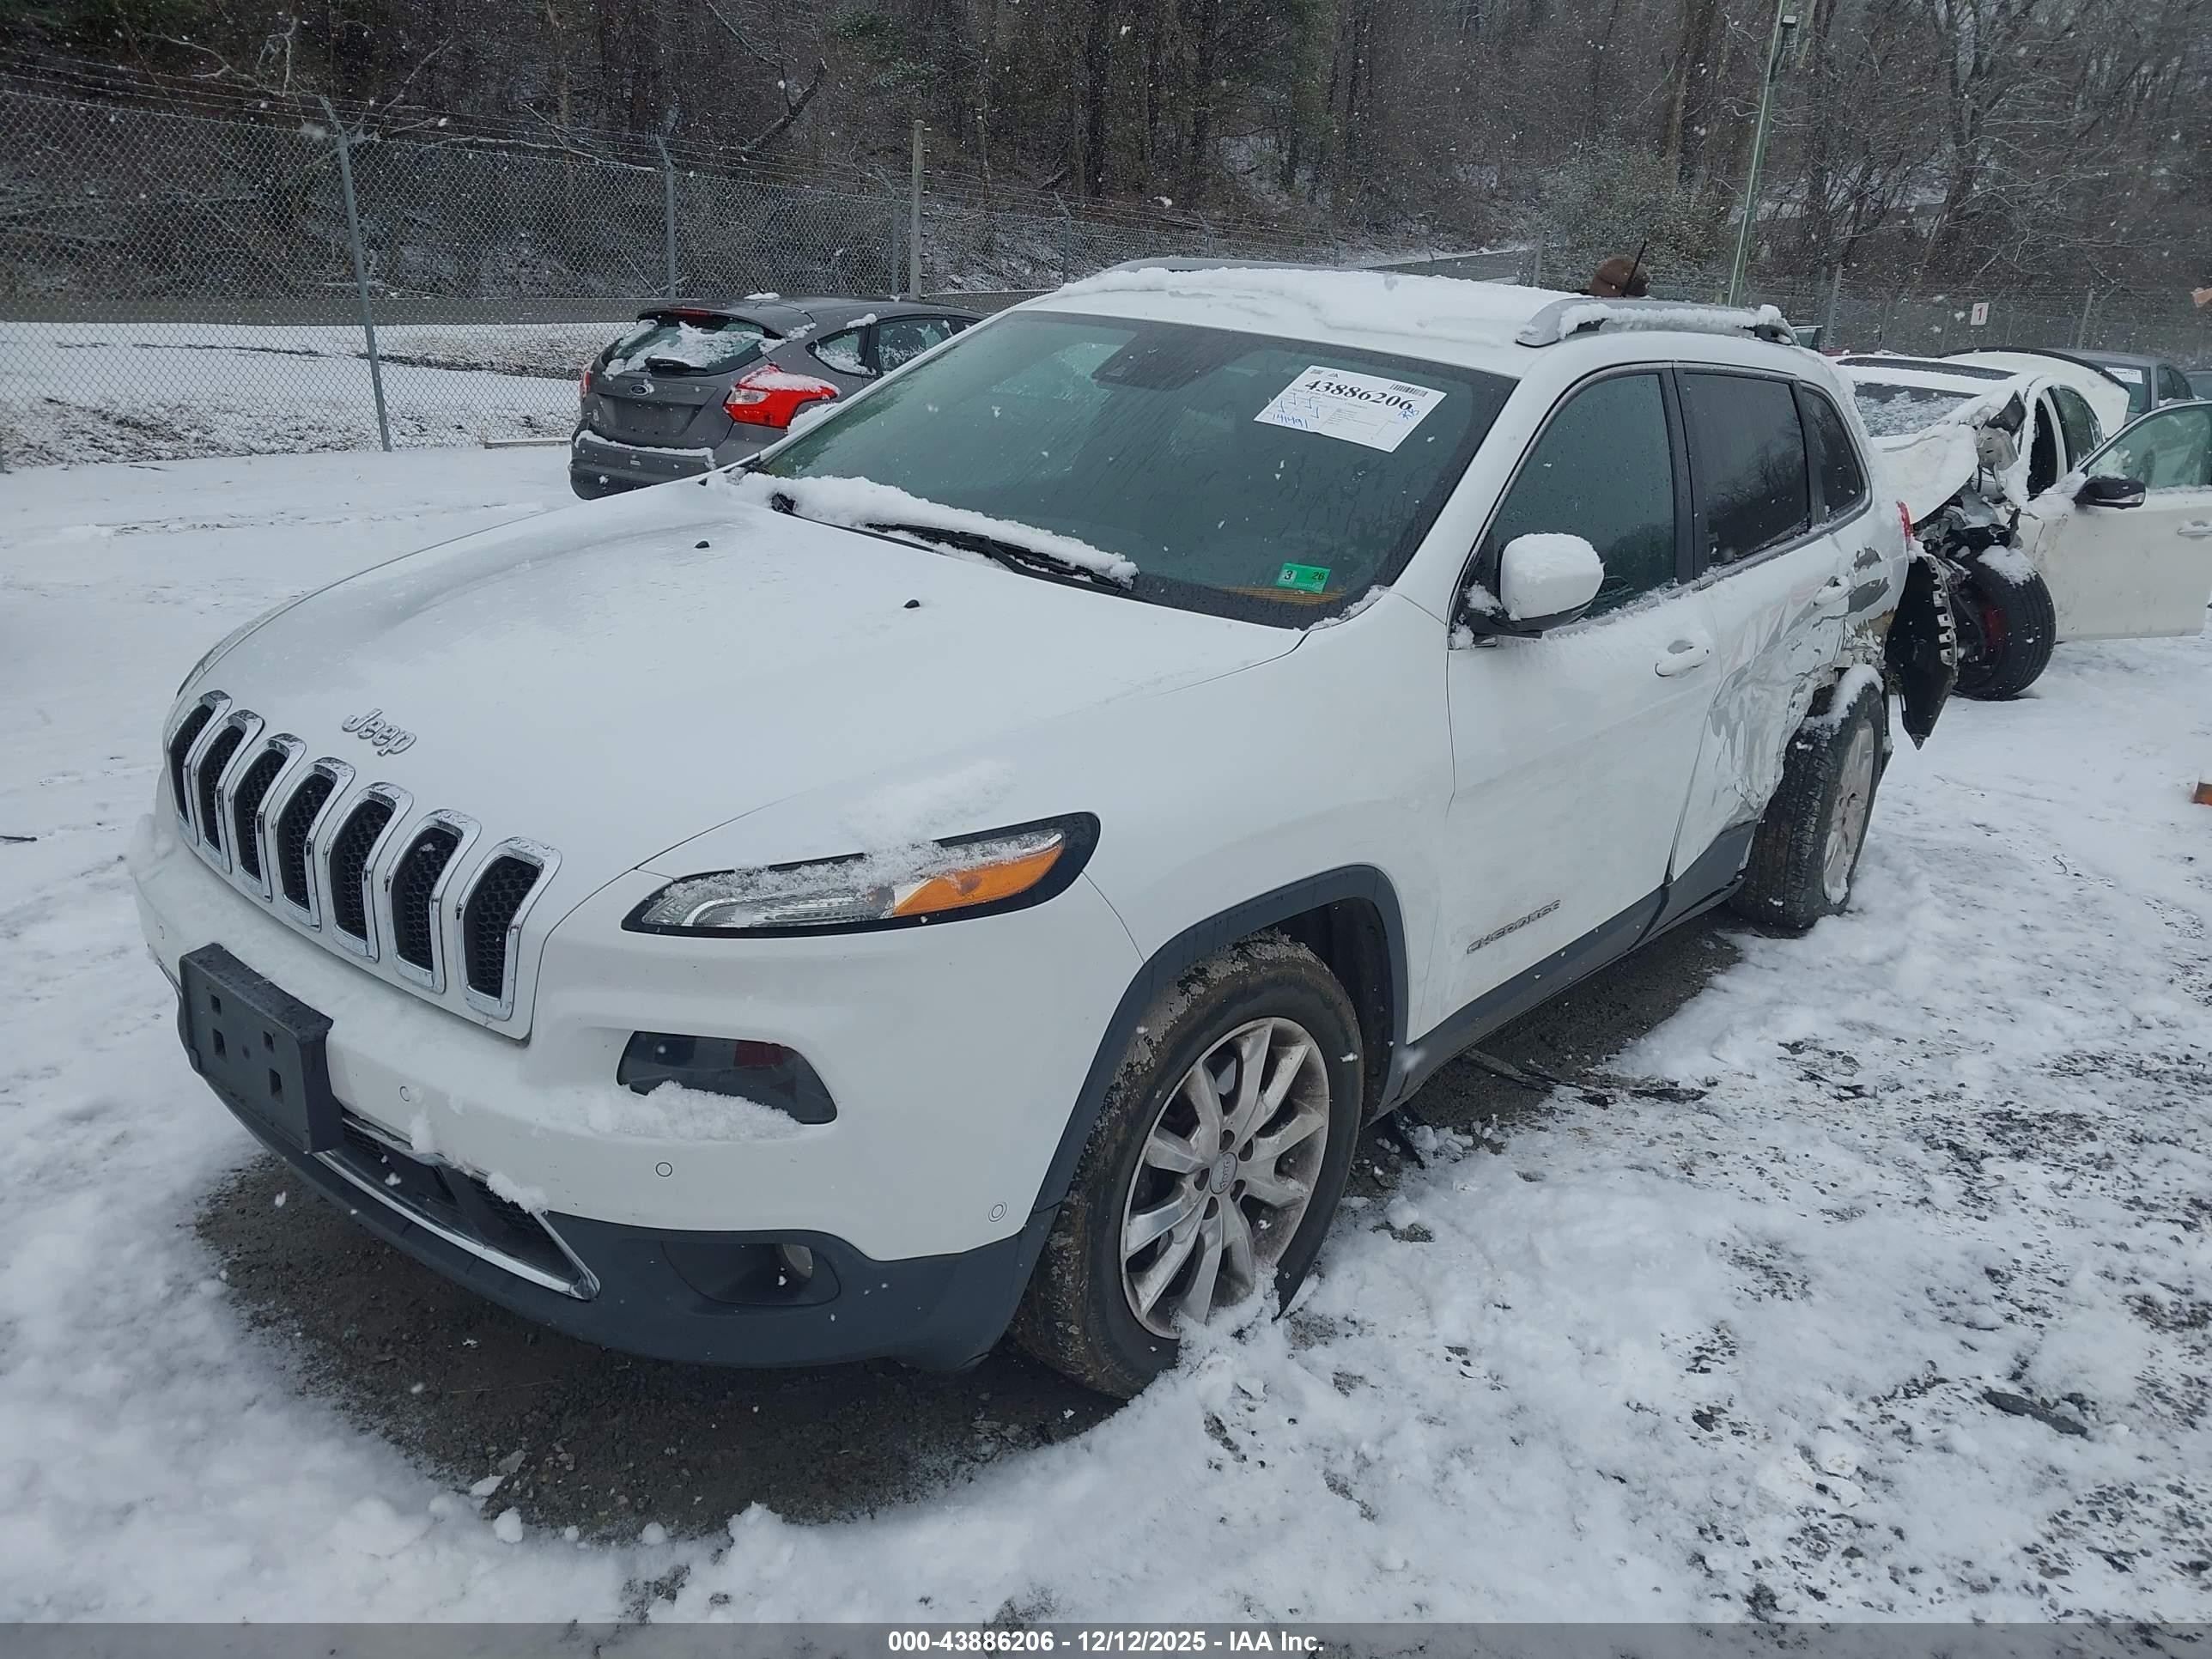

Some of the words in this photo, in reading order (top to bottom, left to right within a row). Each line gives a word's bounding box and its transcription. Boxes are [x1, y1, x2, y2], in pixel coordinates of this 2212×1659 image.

[1978, 307, 1984, 321] 1
[1304, 379, 1417, 410] 43886206
[1284, 569, 1293, 580] 3
[1311, 571, 1326, 581] 26
[342, 708, 417, 757] Jeep
[1466, 899, 1561, 955] CHEROKEE
